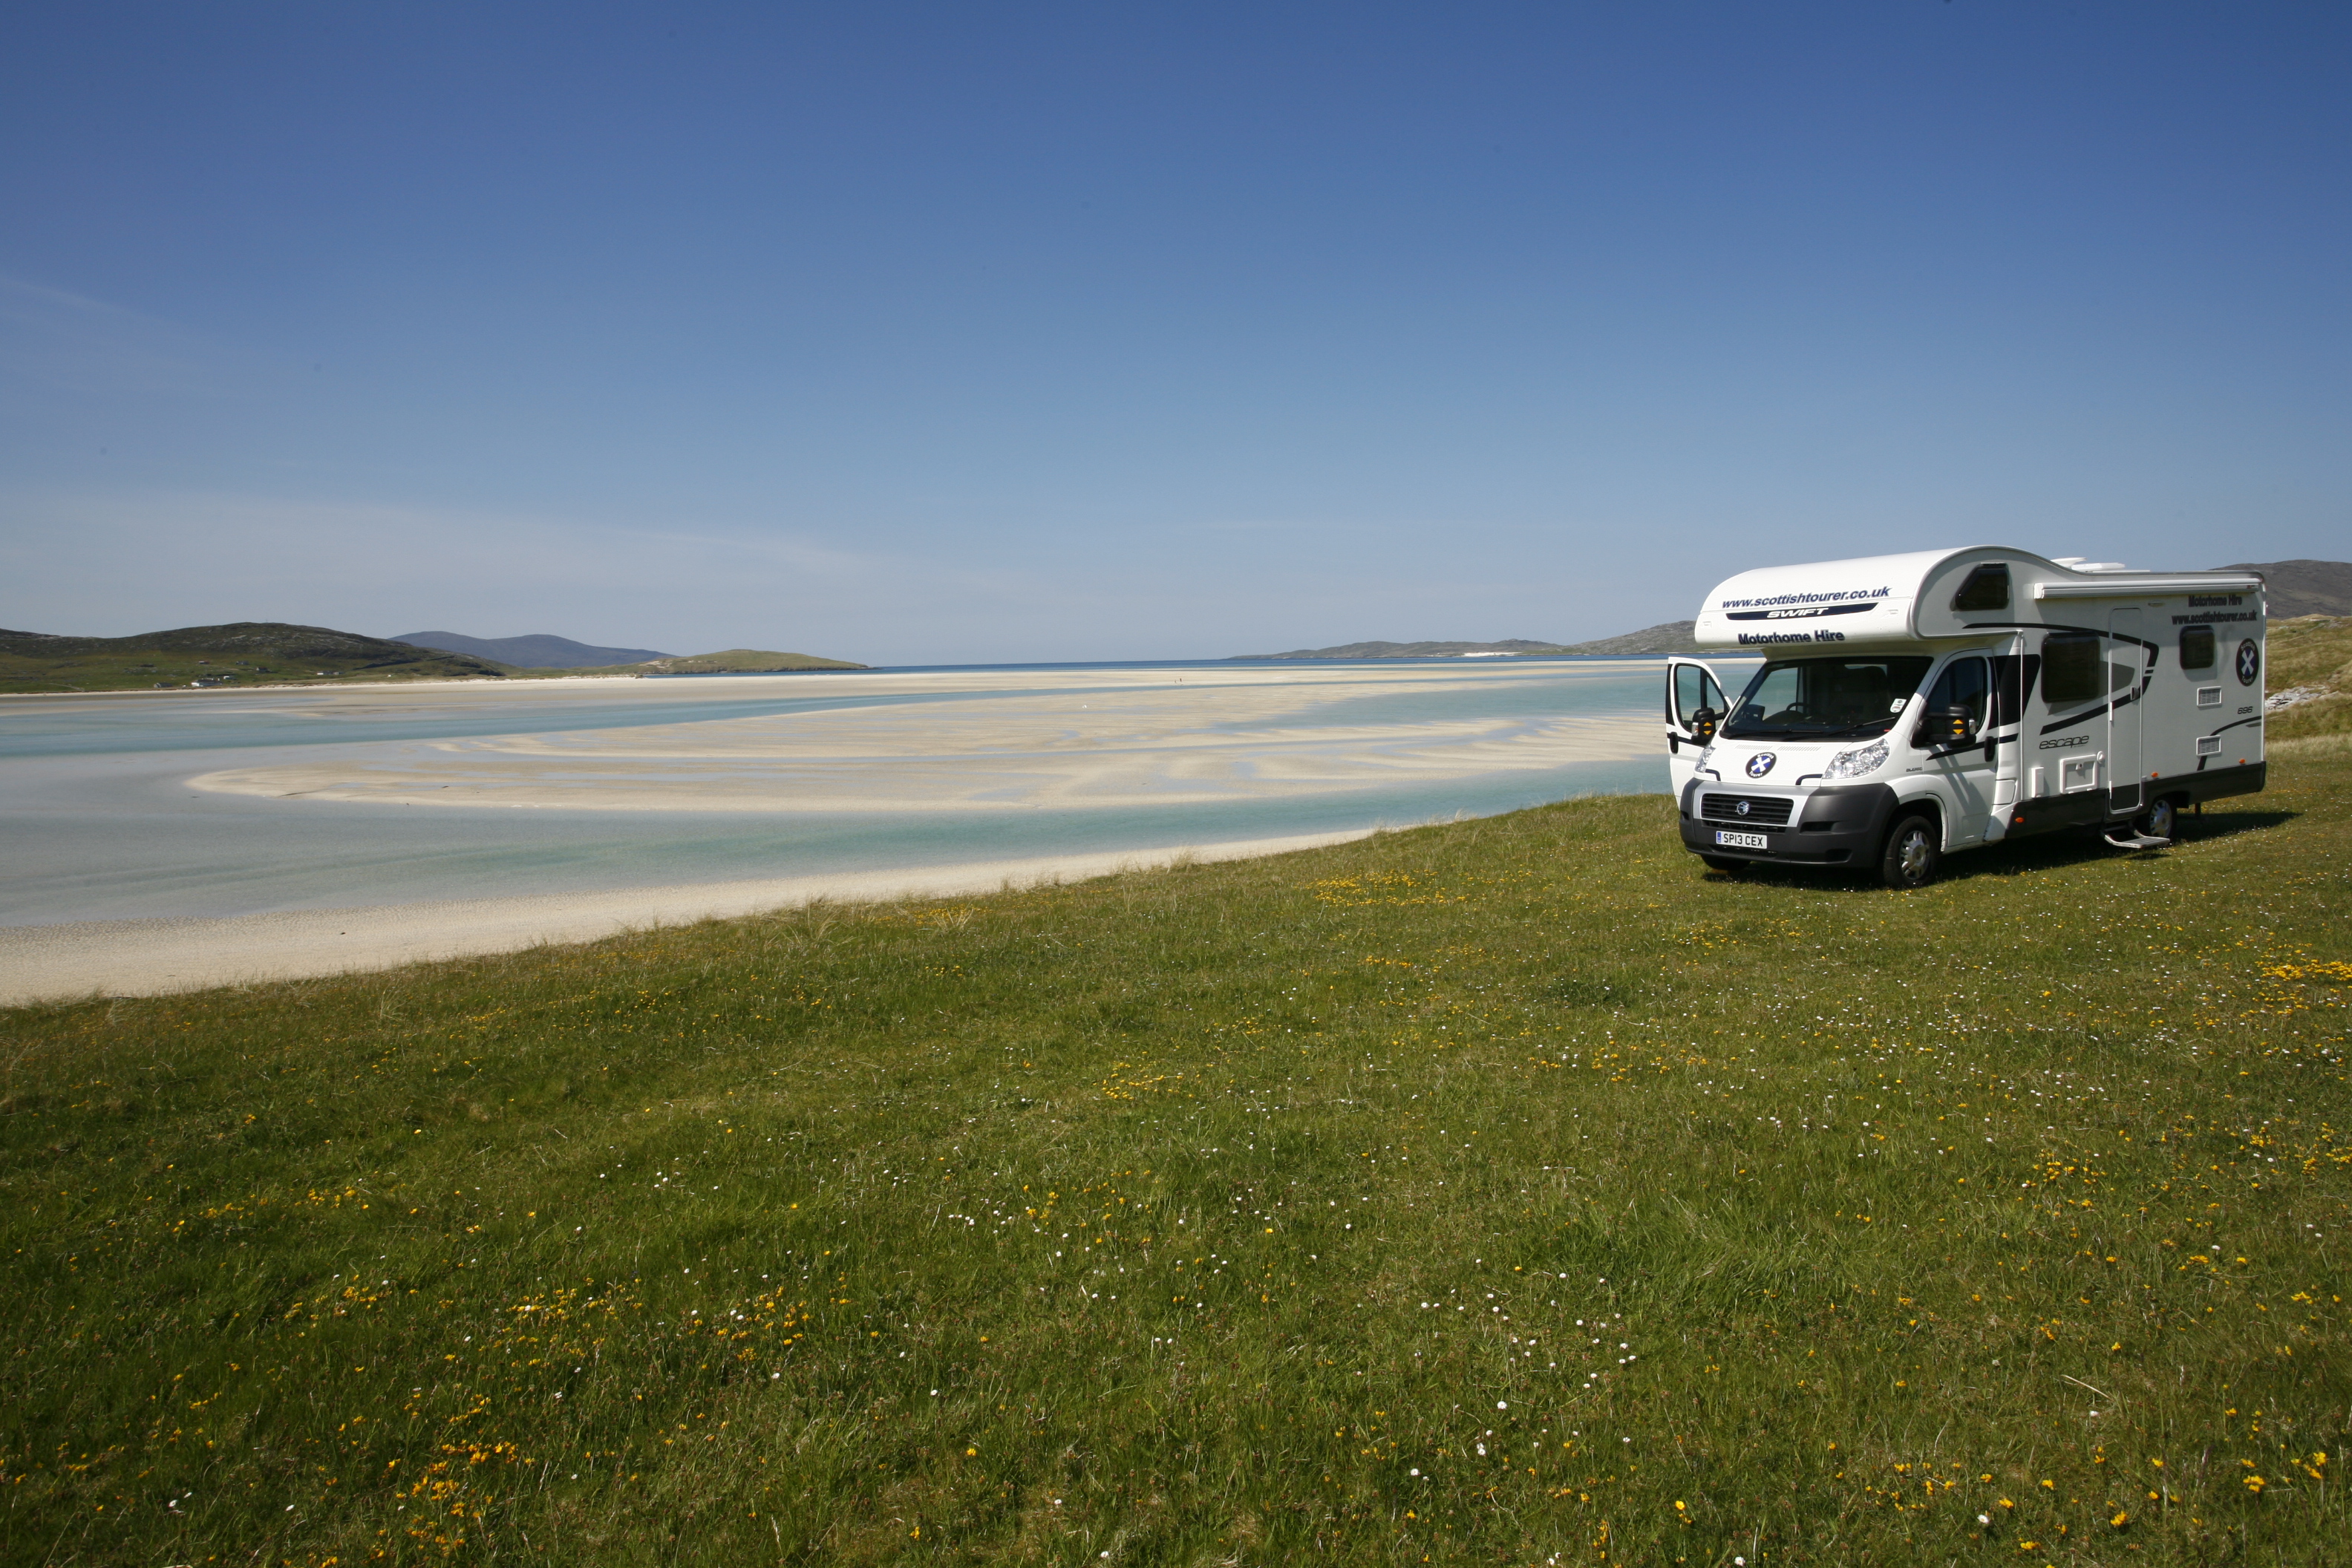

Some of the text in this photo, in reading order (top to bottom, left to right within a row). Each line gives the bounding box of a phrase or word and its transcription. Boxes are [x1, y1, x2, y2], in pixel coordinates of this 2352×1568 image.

[1722, 586, 1892, 609] www.scottishtourer.co.uk
[2188, 593, 2242, 607] Motorhome Hire
[1766, 607, 1829, 618] SWIFT
[2172, 609, 2257, 625] www.scottishtourer.co.uk
[1738, 630, 1845, 645] Motorhome Hire
[2237, 706, 2253, 714] 696
[2039, 735, 2089, 749] escape
[1723, 833, 1763, 847] SP13 CEX
